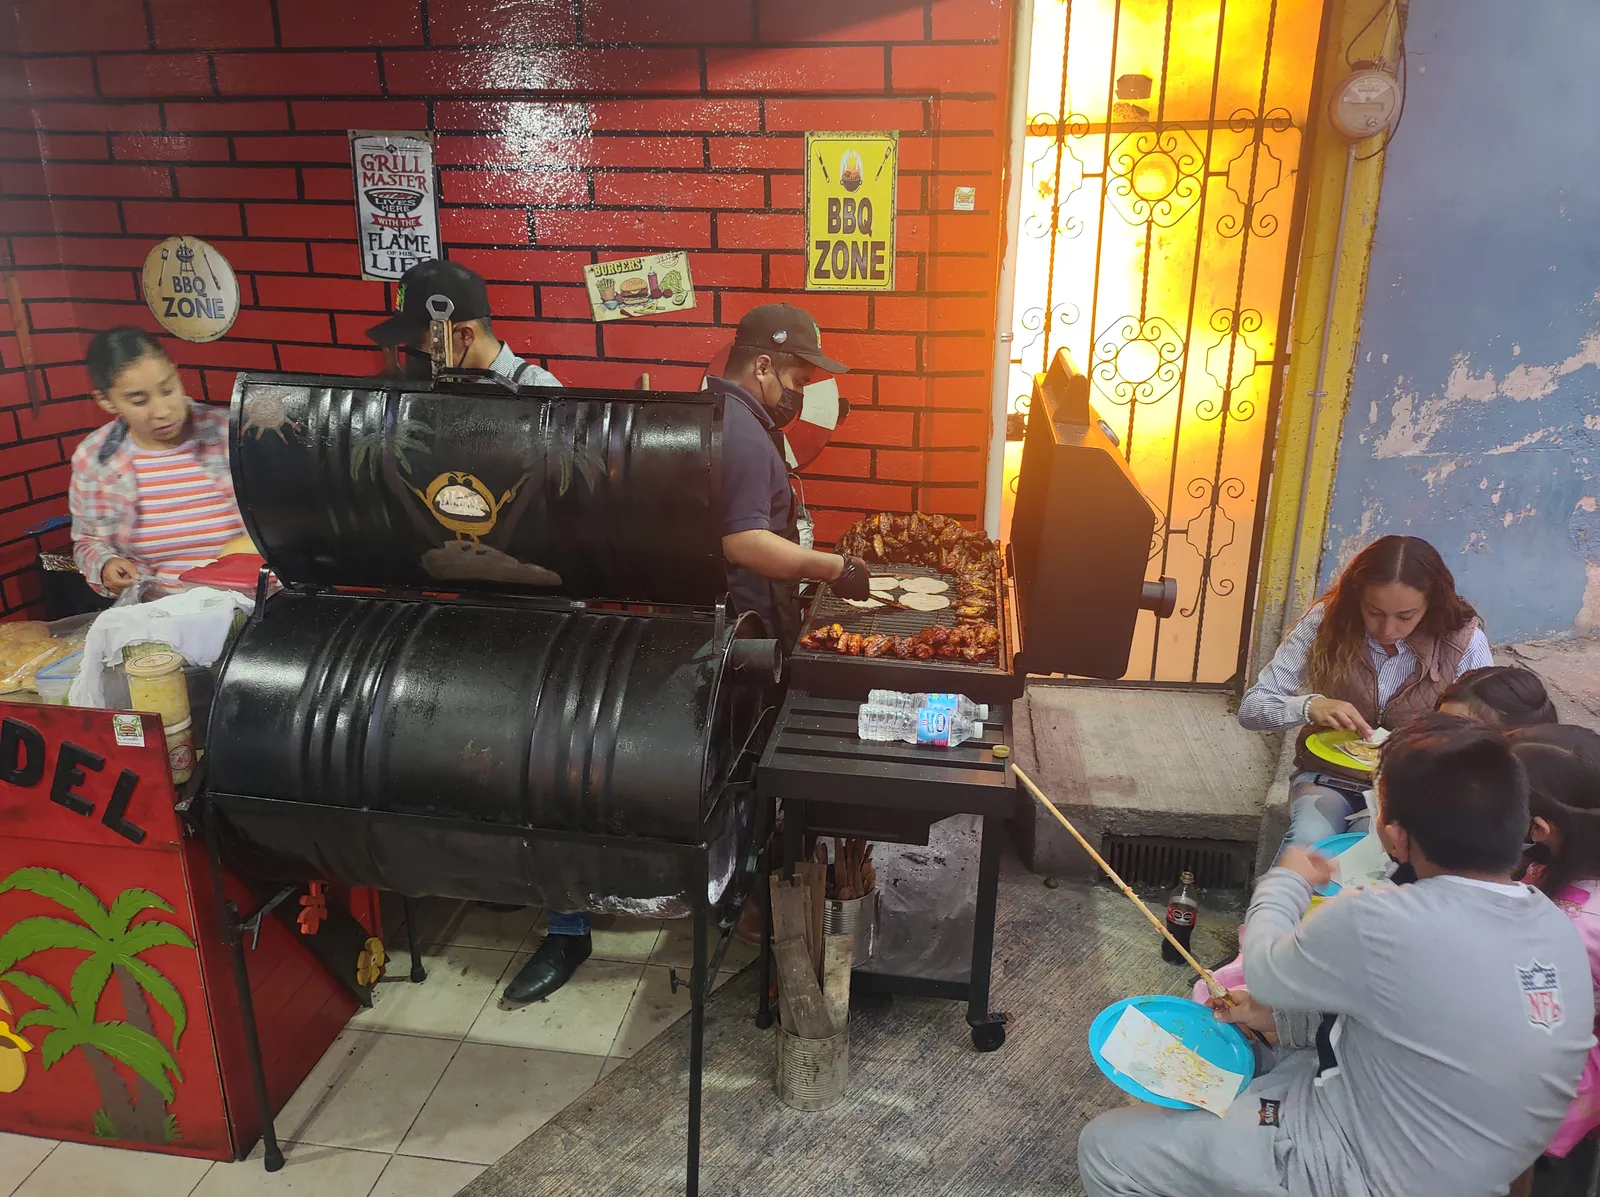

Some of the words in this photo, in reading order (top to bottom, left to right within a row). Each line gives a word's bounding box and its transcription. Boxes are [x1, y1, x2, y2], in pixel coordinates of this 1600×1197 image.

[360, 153, 425, 174] GRILL
[362, 171, 429, 193] MASTER
[375, 197, 416, 207] LIVES
[381, 205, 410, 213] HERE
[377, 217, 399, 227] WITH
[400, 218, 416, 227] THE
[827, 197, 873, 238] BBQ
[368, 232, 432, 255] FLAME
[593, 259, 643, 278] BURGERS
[814, 240, 886, 281] ZONE
[172, 276, 207, 298] BBQ
[162, 297, 226, 319] ZONE
[0, 716, 147, 845] DEL
[1528, 991, 1562, 1025] NFL
